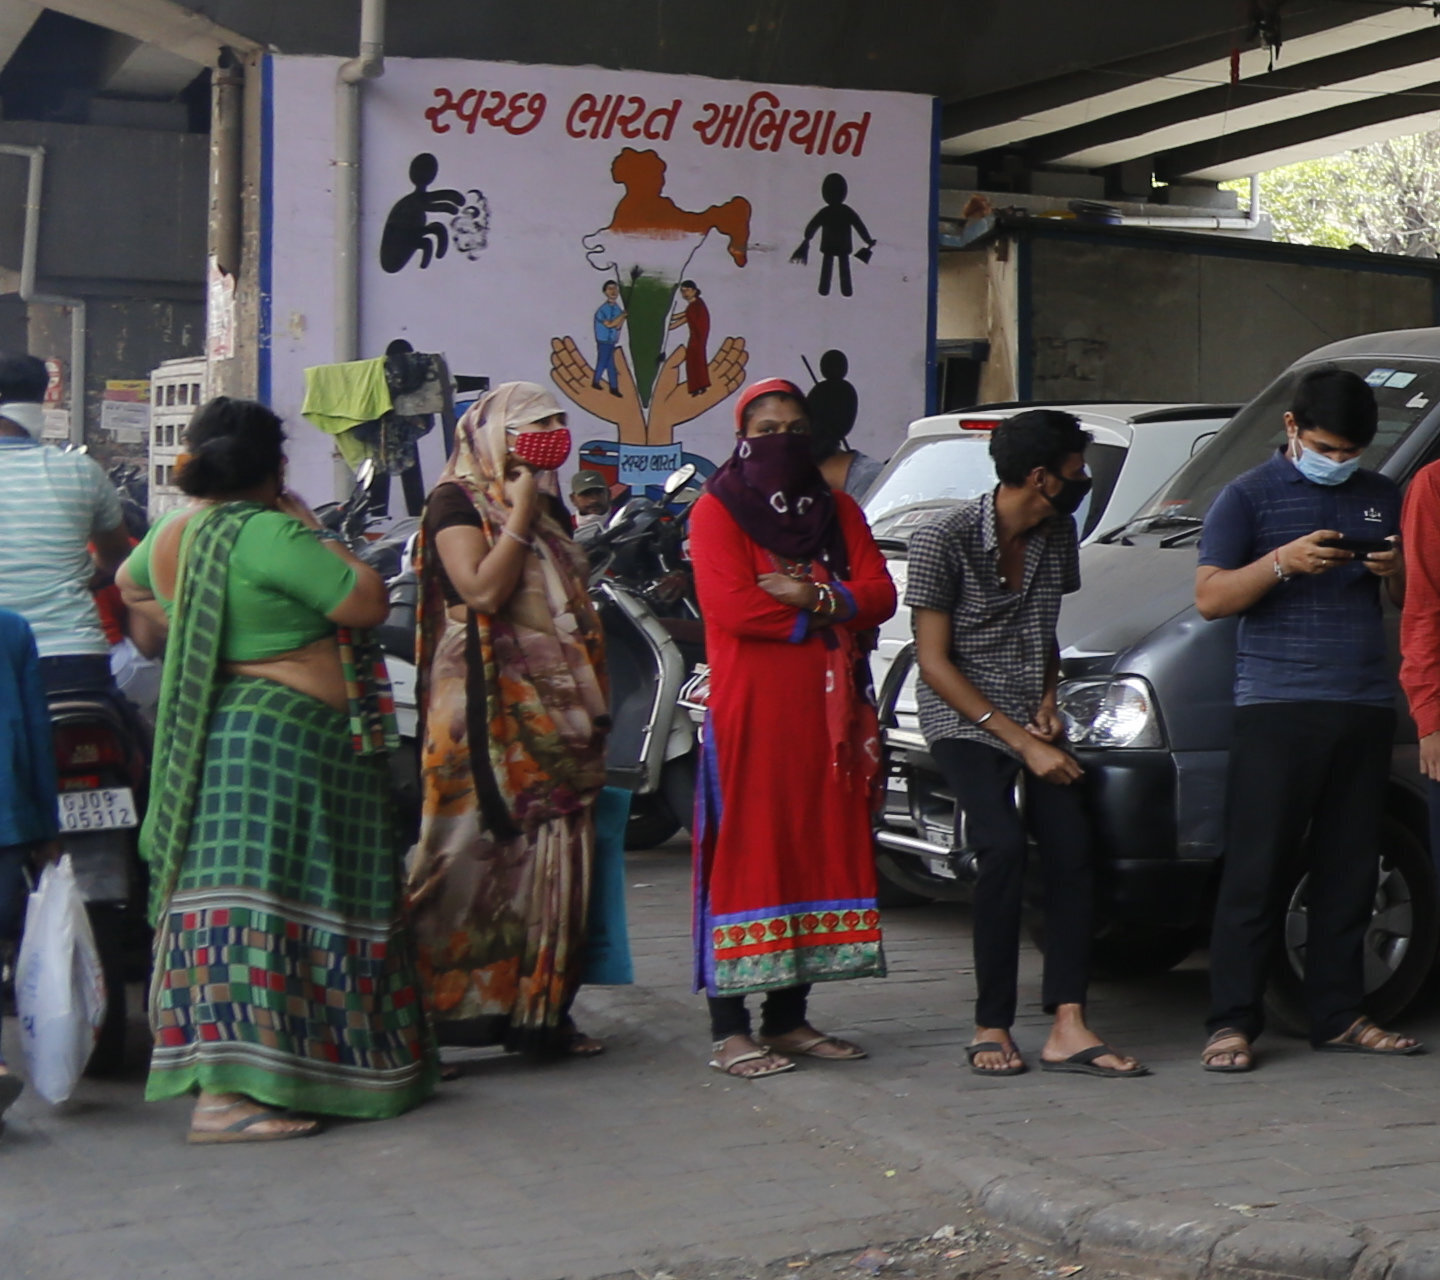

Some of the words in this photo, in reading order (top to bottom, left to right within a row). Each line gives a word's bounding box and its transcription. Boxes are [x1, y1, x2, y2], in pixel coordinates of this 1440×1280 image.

[424, 87, 547, 136] સ્વચ્છ
[565, 92, 682, 141] ભારત
[692, 90, 871, 157] અભિયાન
